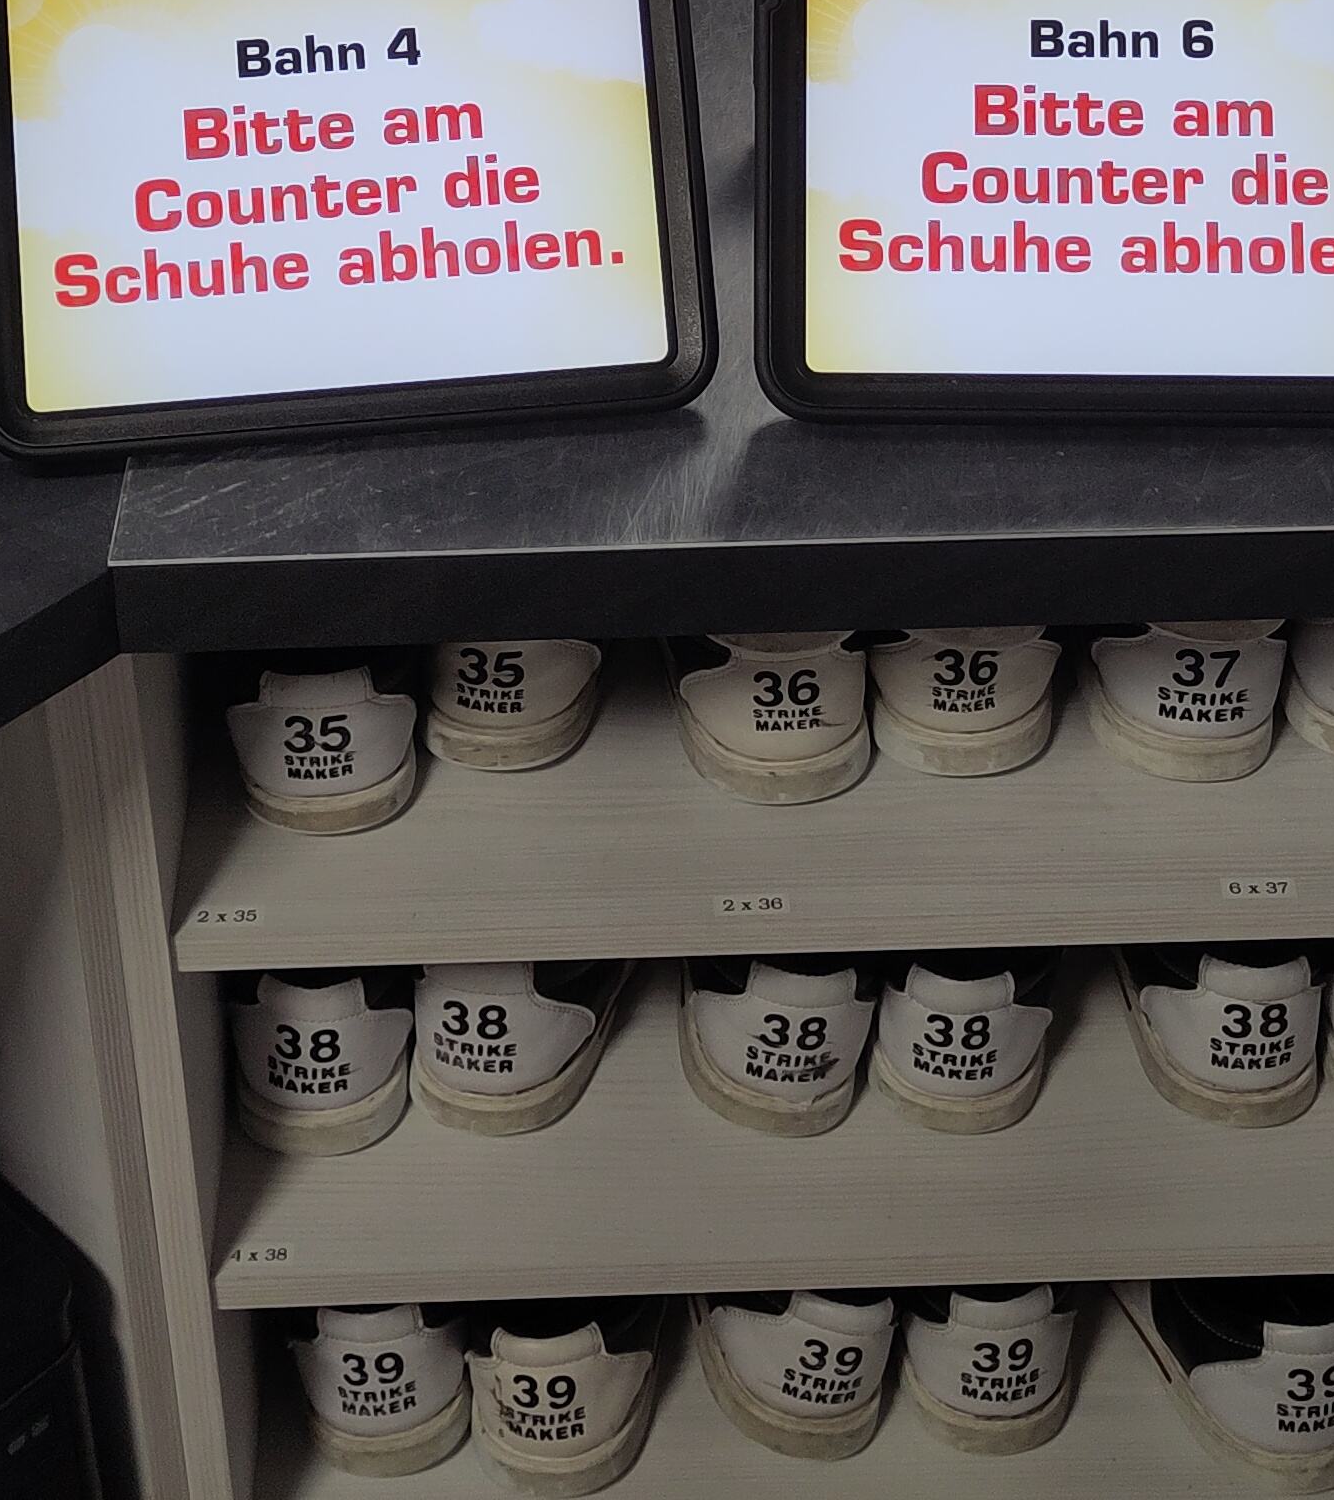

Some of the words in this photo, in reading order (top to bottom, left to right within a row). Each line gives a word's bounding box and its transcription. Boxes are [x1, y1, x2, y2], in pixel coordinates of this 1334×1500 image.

[1029, 19, 1160, 59] Bahn
[1181, 19, 1215, 59] 6
[236, 36, 366, 78] Bahn
[387, 27, 421, 66] 4
[974, 84, 1144, 137] Bitte
[1172, 97, 1275, 137] am
[183, 106, 355, 160] Bitte
[383, 101, 483, 145] am
[921, 151, 1204, 205] Counter
[1231, 153, 1330, 206] die
[134, 174, 418, 232] Counter
[443, 155, 541, 208] die
[838, 219, 1092, 273] Schuhe
[54, 241, 310, 308] Schuhe
[338, 221, 626, 286] abholen.
[458, 649, 525, 688] 35
[933, 650, 998, 686] 36
[1172, 650, 1241, 688] 37
[456, 683, 524, 700] STRIKE
[753, 669, 821, 707] 36
[931, 683, 997, 701] STRIKE
[1157, 684, 1249, 706] STRIKE
[459, 698, 523, 714] MAKER
[753, 706, 823, 720] STRIKE
[932, 698, 996, 713] MAKER
[1157, 703, 1245, 724] MAKER
[284, 715, 351, 753] 35
[755, 718, 821, 732] MAKER
[284, 752, 355, 767] STRIKE
[287, 764, 354, 780] MAKER
[1229, 882, 1241, 894] 6
[1264, 881, 1288, 894] 37
[197, 911, 209, 923] 2
[233, 909, 257, 923] 35
[723, 900, 735, 912] 2
[758, 898, 783, 911] 36
[442, 1001, 509, 1040] 38
[759, 1014, 827, 1050] 38
[924, 1014, 991, 1050] 38
[1221, 1003, 1288, 1038] 38
[275, 1025, 341, 1062] 38
[434, 1033, 518, 1057] STRIKE
[913, 1043, 998, 1066] STRIKE
[1210, 1035, 1296, 1056] STRIKE
[268, 1055, 351, 1080] STRIKE
[435, 1049, 514, 1074] MAKER
[746, 1046, 832, 1067] STRIKE
[1211, 1051, 1291, 1070] MAKER
[745, 1062, 827, 1082] MAKER
[913, 1057, 994, 1081] MAKER
[269, 1073, 348, 1094] MAKER
[264, 1248, 287, 1260] 38
[799, 1339, 863, 1375] 39
[972, 1338, 1033, 1372] 39
[342, 1352, 404, 1386] 39
[784, 1368, 862, 1391] STRIKE
[961, 1369, 1040, 1389] STRIKE
[337, 1380, 416, 1404] STRIKE
[512, 1375, 576, 1409] 39
[781, 1382, 856, 1405] MAKER
[961, 1382, 1037, 1402] MAKER
[342, 1395, 417, 1417] MAKER
[501, 1406, 586, 1425] STRIKE
[507, 1421, 585, 1440] MAKER
